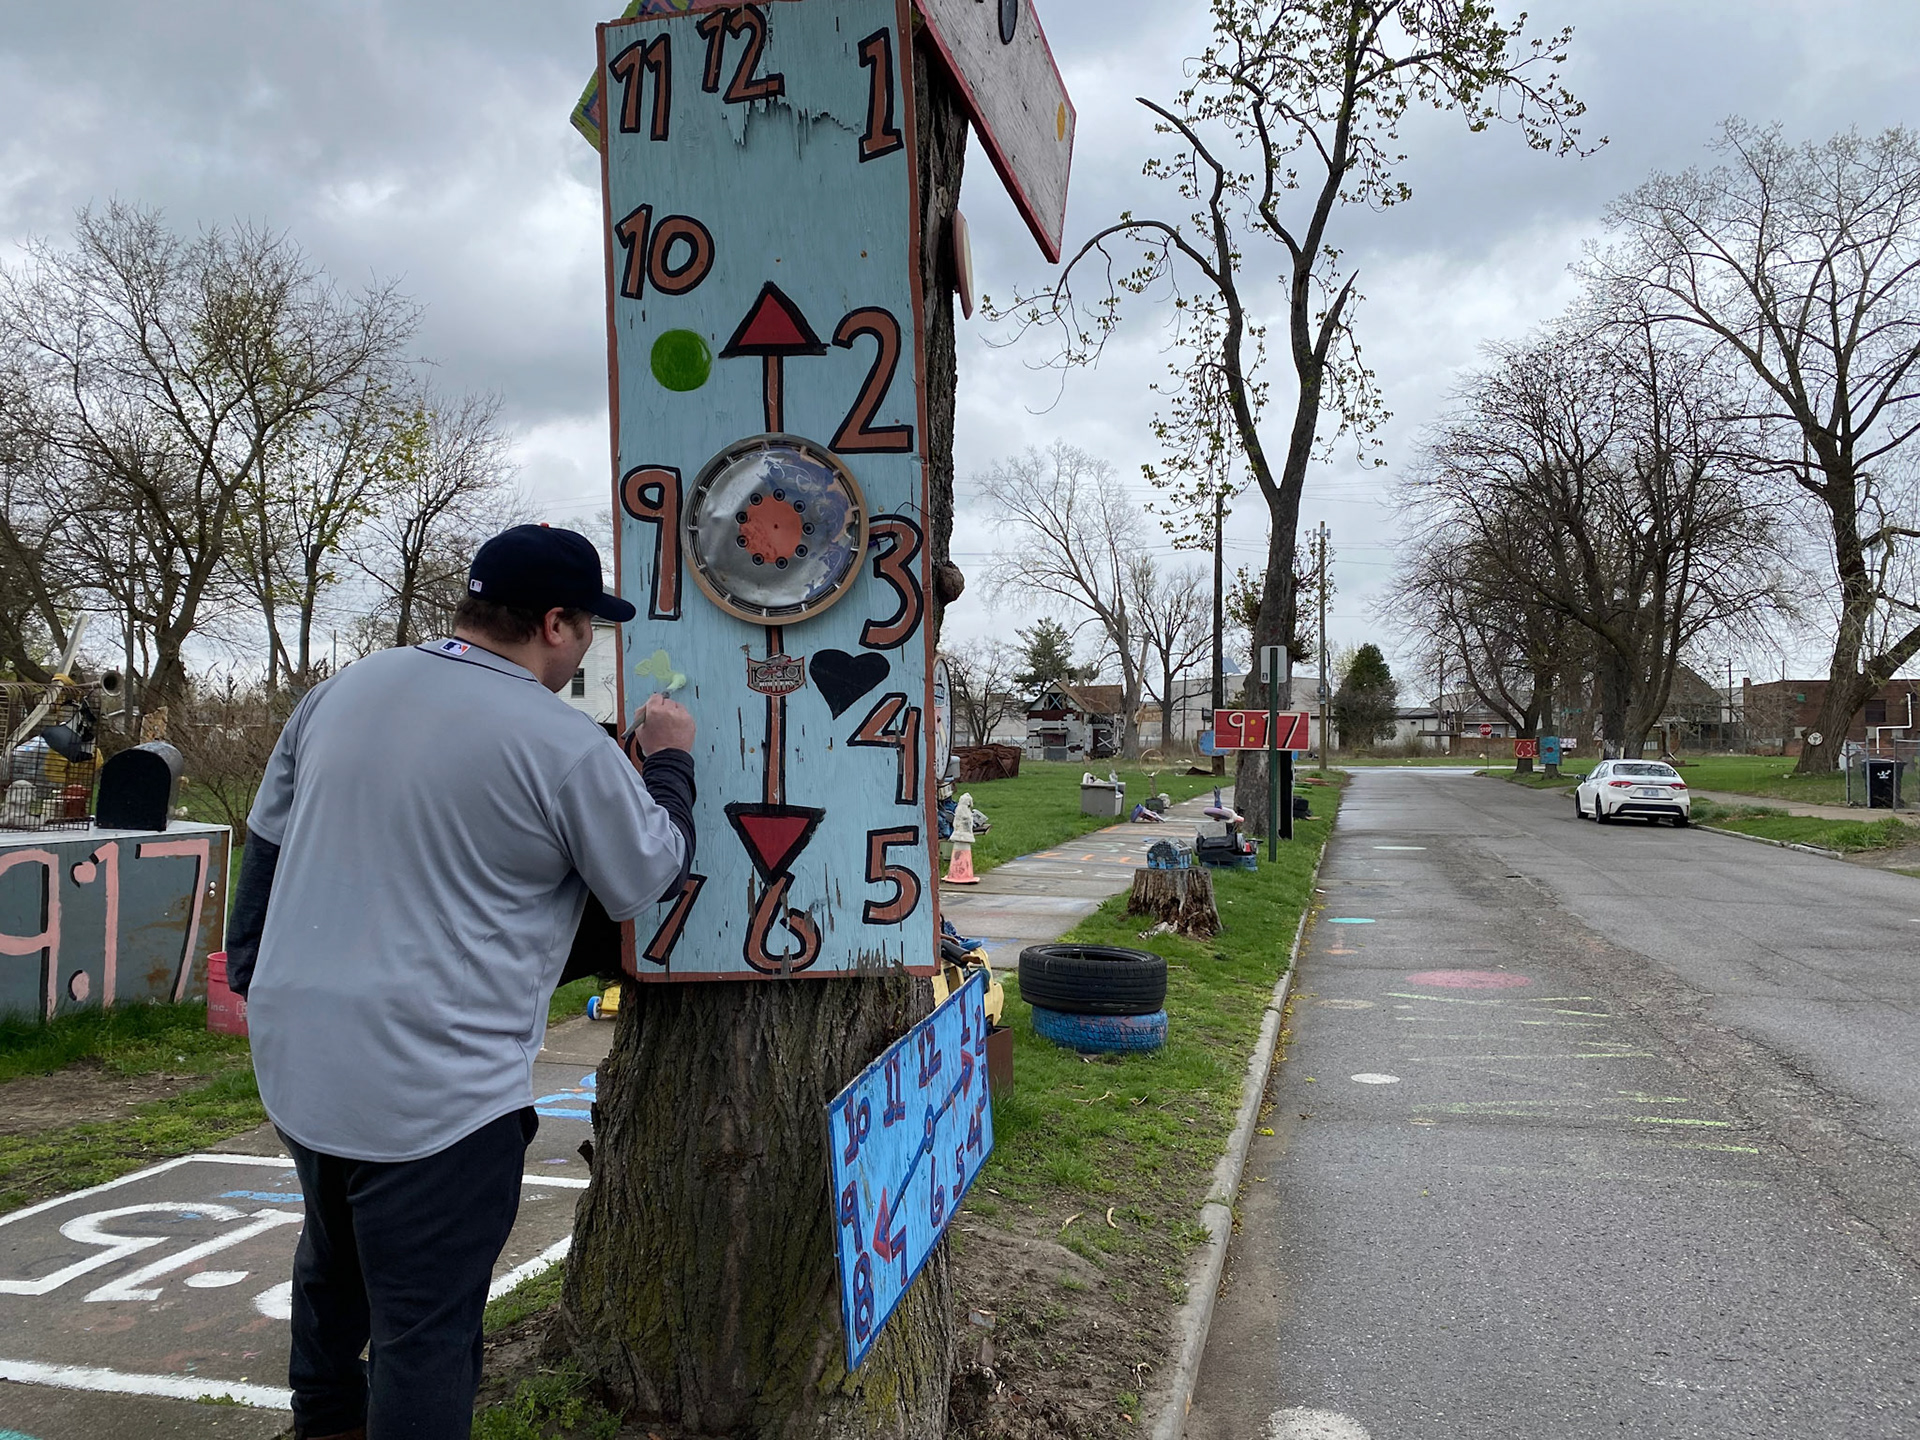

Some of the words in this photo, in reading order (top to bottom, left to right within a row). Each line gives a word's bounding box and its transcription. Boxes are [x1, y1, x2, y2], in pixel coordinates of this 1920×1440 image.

[609, 32, 671, 141] 11
[696, 3, 785, 104] 12
[858, 27, 904, 163] 1
[615, 203, 715, 300] 10
[828, 306, 913, 454] 2
[620, 464, 683, 620] 9
[859, 514, 924, 650] 3
[846, 692, 921, 806] 4
[862, 825, 921, 924] 5
[743, 870, 822, 974] 6
[917, 1024, 942, 1089] 12
[960, 988, 971, 1047] 1
[974, 1004, 985, 1057] 2
[843, 1093, 872, 1167] 10
[883, 1052, 906, 1129] 11
[977, 1063, 988, 1113] 3
[952, 1141, 966, 1201] 5
[966, 1108, 983, 1157] 4
[841, 1180, 864, 1255] 9
[929, 1154, 945, 1229] 6
[853, 1251, 875, 1345] 8
[890, 1225, 909, 1288] 7
